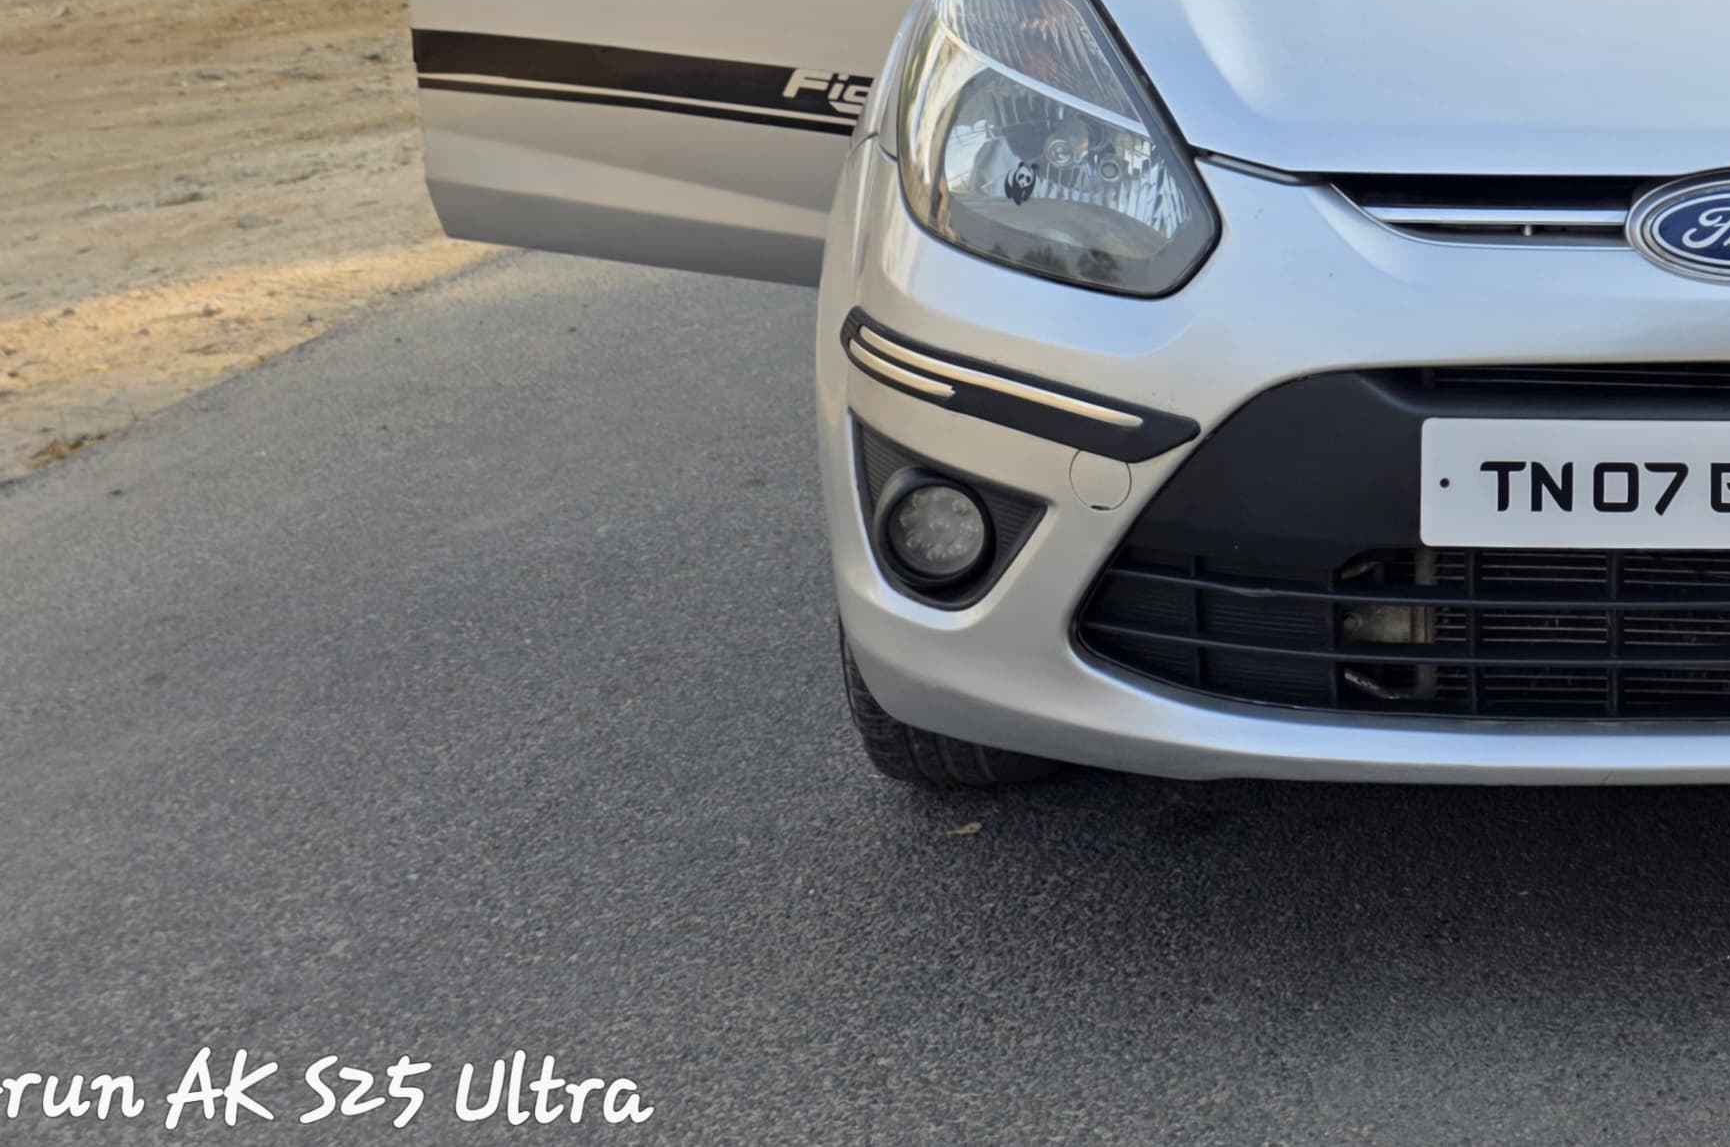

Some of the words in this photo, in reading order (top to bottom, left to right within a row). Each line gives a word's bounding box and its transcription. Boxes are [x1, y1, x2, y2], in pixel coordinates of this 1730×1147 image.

[782, 68, 874, 115] Fig
[1480, 461, 1573, 512] TN
[1592, 462, 1689, 516] 07
